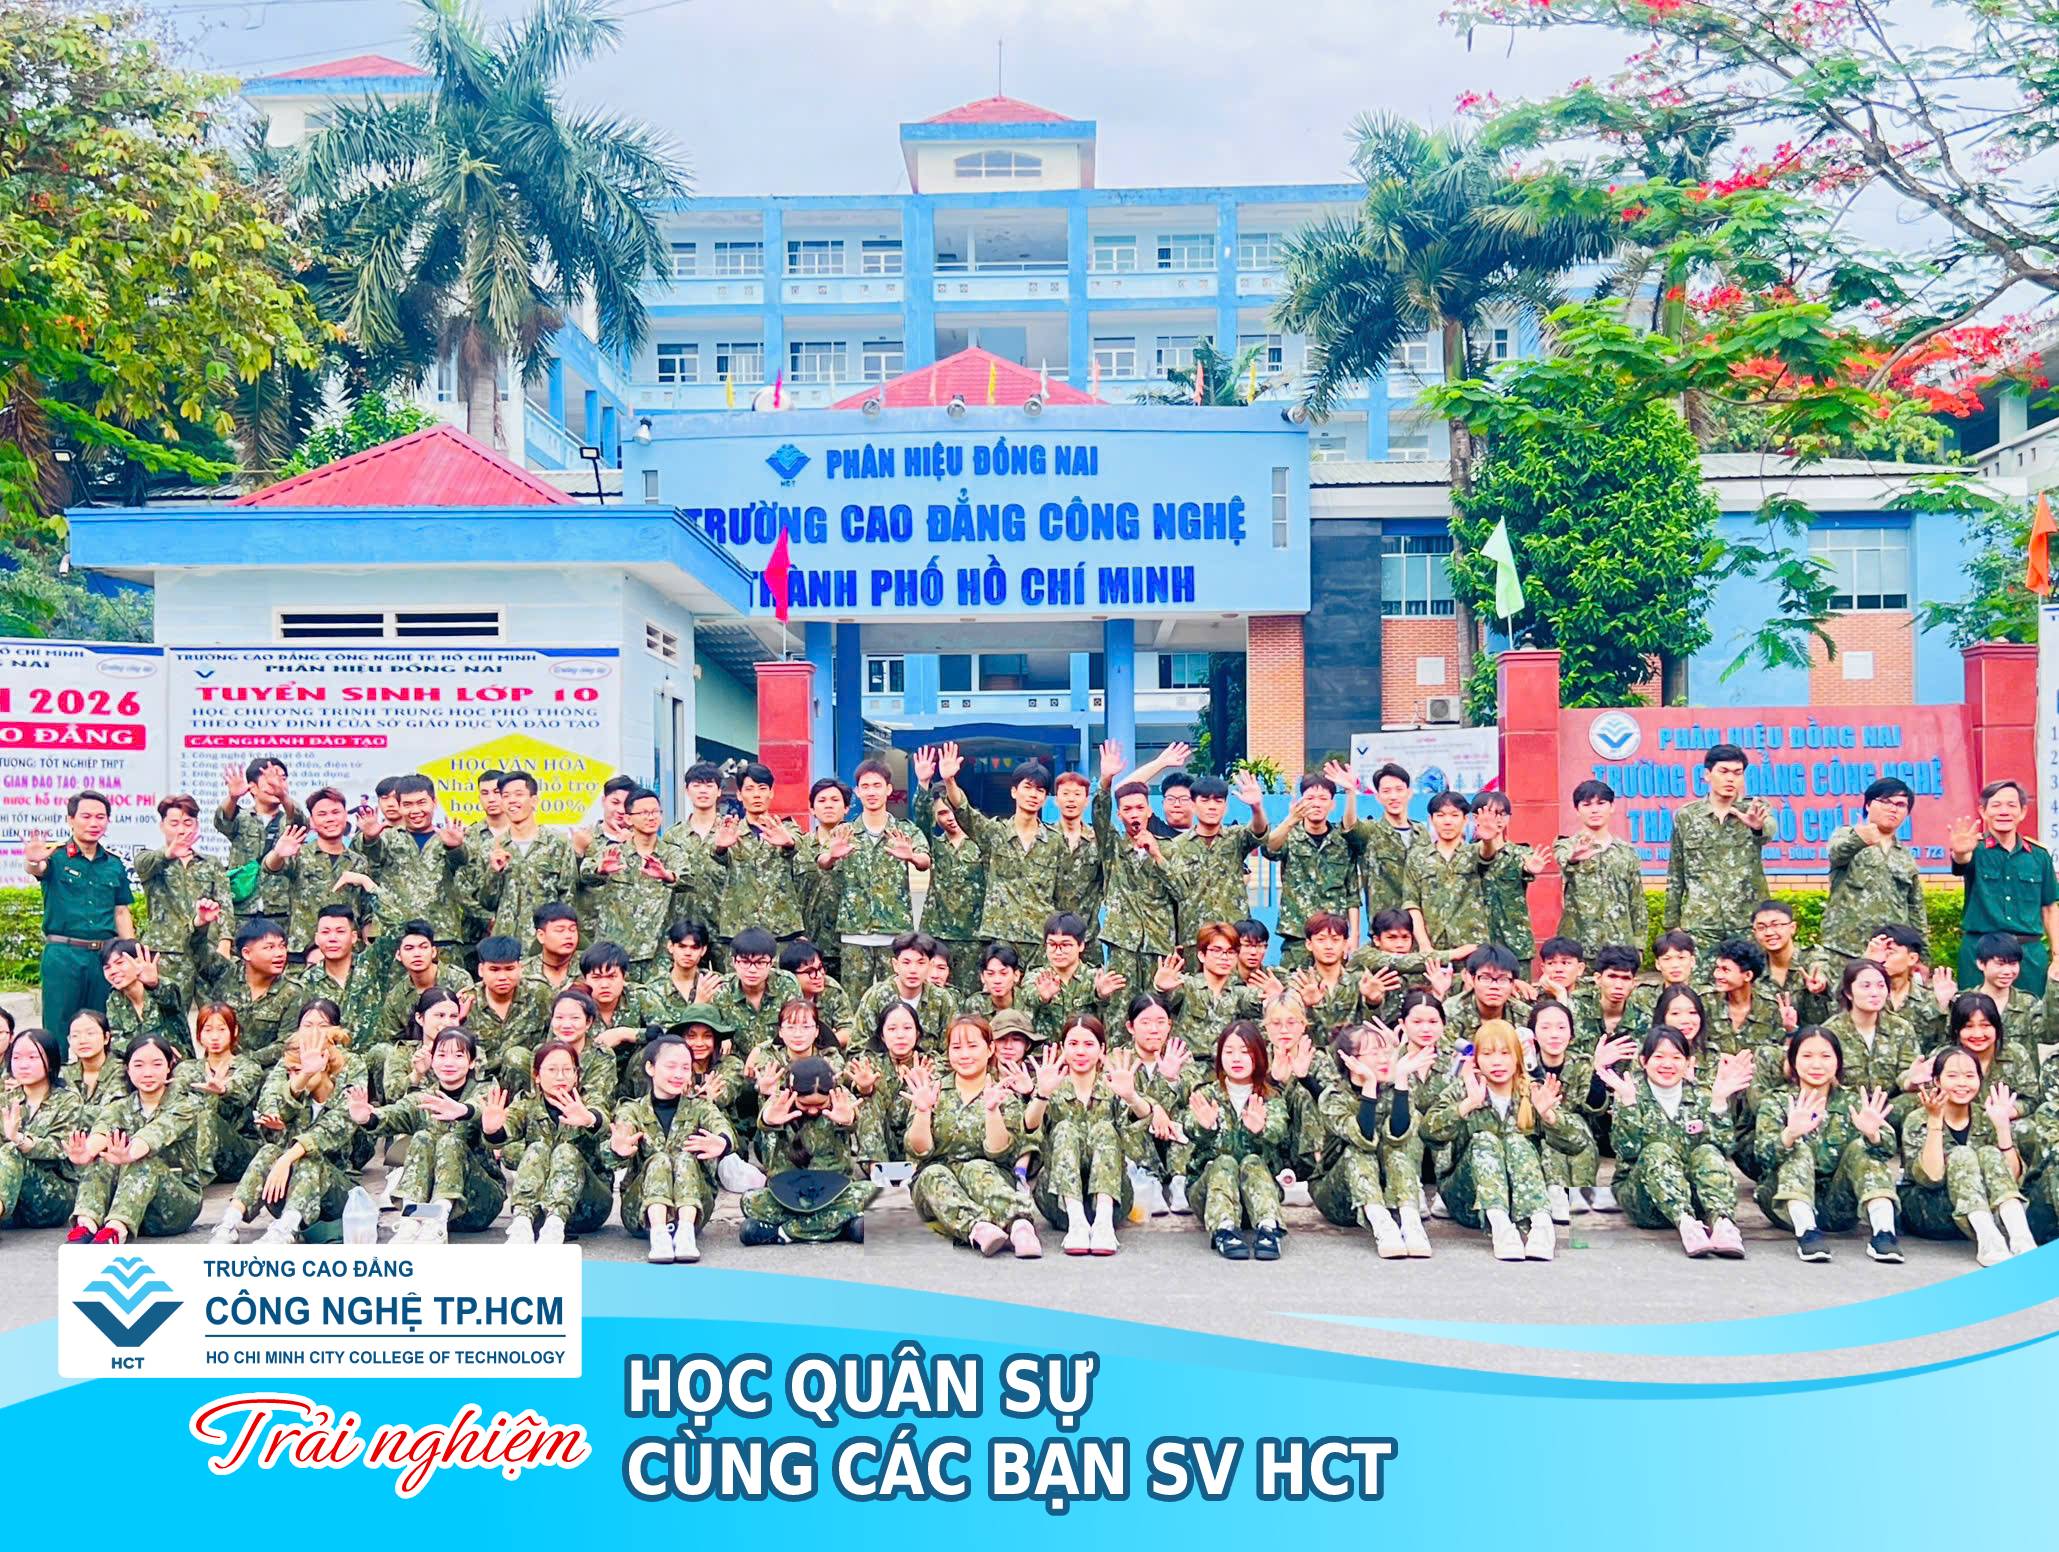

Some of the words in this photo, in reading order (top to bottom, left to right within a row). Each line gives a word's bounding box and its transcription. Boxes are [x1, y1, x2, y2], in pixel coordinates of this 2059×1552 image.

[826, 443, 895, 479] PHÂN
[904, 441, 963, 481] HIỆU
[973, 436, 1046, 476] ĐỒNG
[1055, 446, 1098, 475] NAI
[682, 500, 828, 546] TRƯỜNG
[841, 504, 913, 543] CAO
[926, 487, 1026, 542] ĐẲNG
[1039, 495, 1140, 542] CÔNG
[1153, 495, 1246, 547] NGHỆ
[871, 555, 944, 607] PHỐ
[957, 553, 1007, 606] HỒ
[1021, 561, 1086, 606] CHÍ
[1098, 565, 1195, 605] MINH
[46, 649, 84, 657] MINH
[325, 653, 368, 661] CÔNG
[12, 660, 50, 668] NAI
[266, 663, 325, 673] PHÂN
[333, 663, 382, 674] HIỆU
[464, 665, 502, 673] NAI
[195, 680, 326, 701] TUYỂN
[342, 686, 440, 701] SINH
[457, 684, 534, 701] LỚP
[555, 687, 599, 702] 10
[29, 688, 141, 716] 2026
[192, 707, 230, 717] HỌC
[382, 708, 443, 716] TRUNG
[449, 708, 487, 717] HỌC
[535, 707, 598, 716] THÔNG
[191, 719, 238, 728] THEO
[244, 719, 284, 729] QUY
[456, 719, 493, 729] DỤC
[33, 723, 133, 744] ĐẲNG
[1658, 723, 1720, 750] PHÂN
[1727, 721, 1783, 752] HIỆU
[1789, 716, 1855, 748] ĐỒNG
[1863, 725, 1902, 748] NAI
[190, 735, 225, 746] CÁC
[228, 735, 304, 746] NGHÀNH
[350, 737, 385, 748] TẠO
[101, 759, 125, 769] THPT
[3, 775, 29, 788] GIAN
[1592, 758, 1687, 798] TRƯỜNG
[1812, 755, 1876, 796] CÔNG
[534, 802, 586, 813] 00%
[1626, 804, 1672, 844] THÀ
